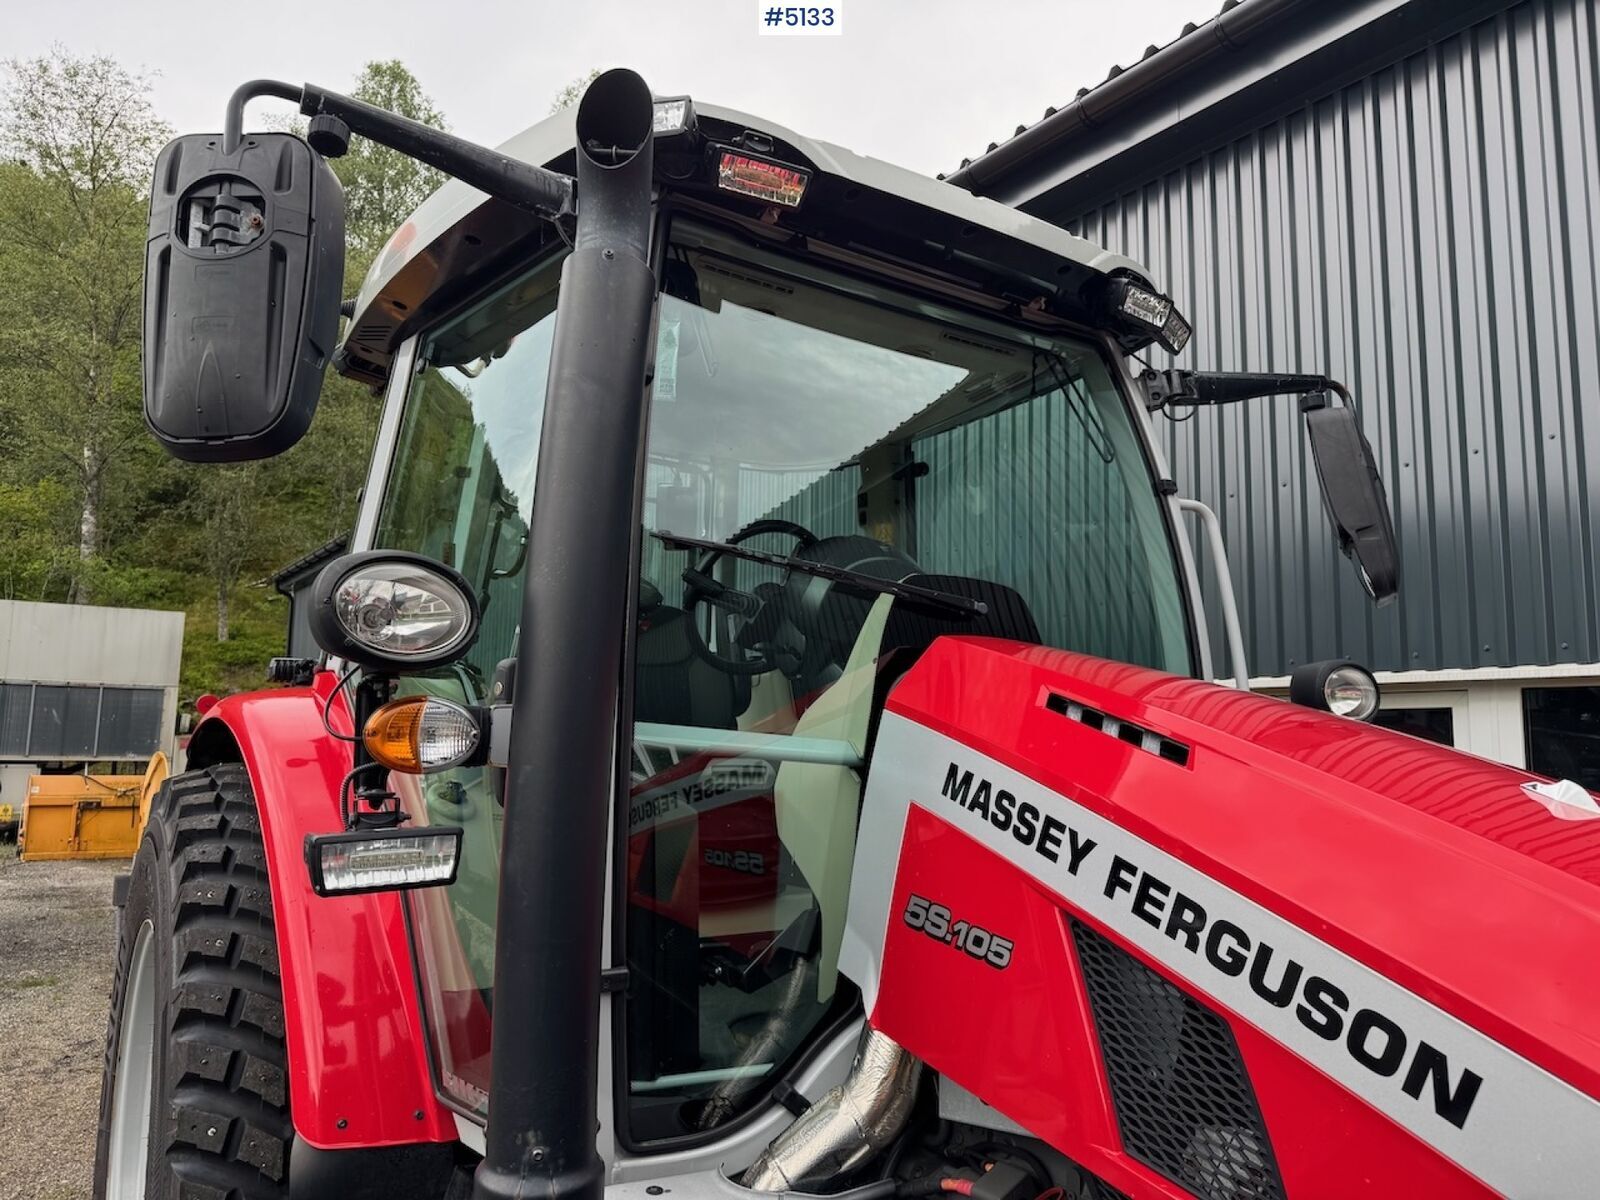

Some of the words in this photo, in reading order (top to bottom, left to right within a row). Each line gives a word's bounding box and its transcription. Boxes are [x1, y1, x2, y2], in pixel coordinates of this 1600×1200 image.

[903, 893, 1014, 970] 5S.105
[941, 762, 1097, 876] MASSEY
[1103, 855, 1483, 1130] FERGUSON
